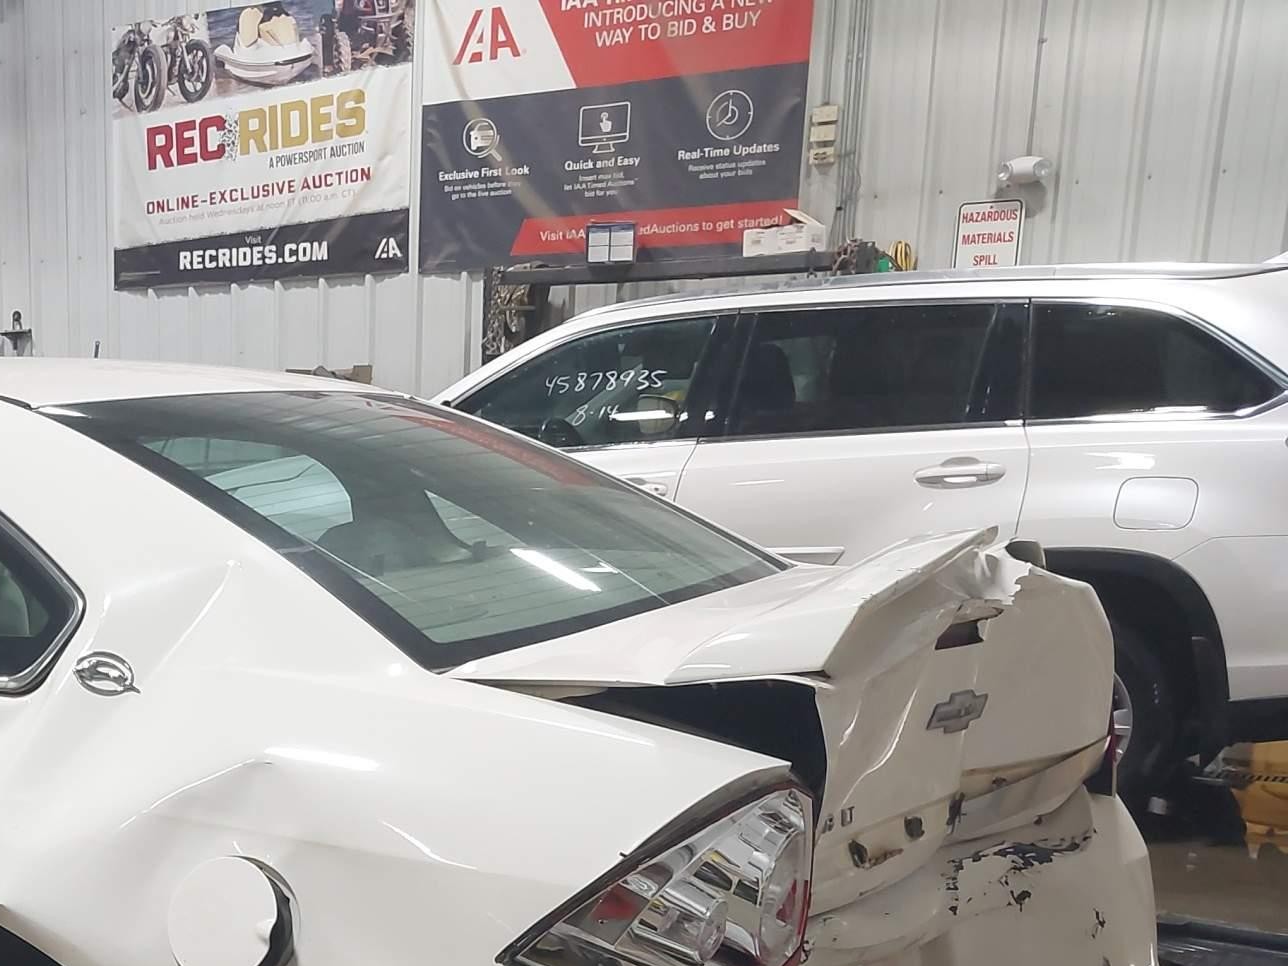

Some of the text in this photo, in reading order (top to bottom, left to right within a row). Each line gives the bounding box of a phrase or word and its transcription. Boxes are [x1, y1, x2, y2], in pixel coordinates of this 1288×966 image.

[584, 0, 706, 29] INTRODUCING
[595, 9, 762, 48] WAY TO BID & BUY
[146, 88, 366, 171] REC RIDES
[268, 141, 365, 169] A POWERSPORT AUCTION
[564, 155, 641, 171] Quick and Easy
[677, 143, 780, 161] Real-Time Updates
[438, 164, 530, 182] Exclusive First Look
[146, 166, 372, 215] ONLINE-EXCLUSIVE AUCTION
[539, 229, 564, 241] Visit
[701, 221, 713, 231] to
[716, 219, 735, 232] get
[737, 215, 783, 229] started!
[962, 209, 1018, 225] HAZARDOUS
[244, 235, 263, 245] Visit
[962, 232, 1015, 246] MATERIALS
[179, 240, 329, 270] RECRIDES.COM
[972, 254, 998, 267] SPILL
[545, 370, 668, 397] 45878935
